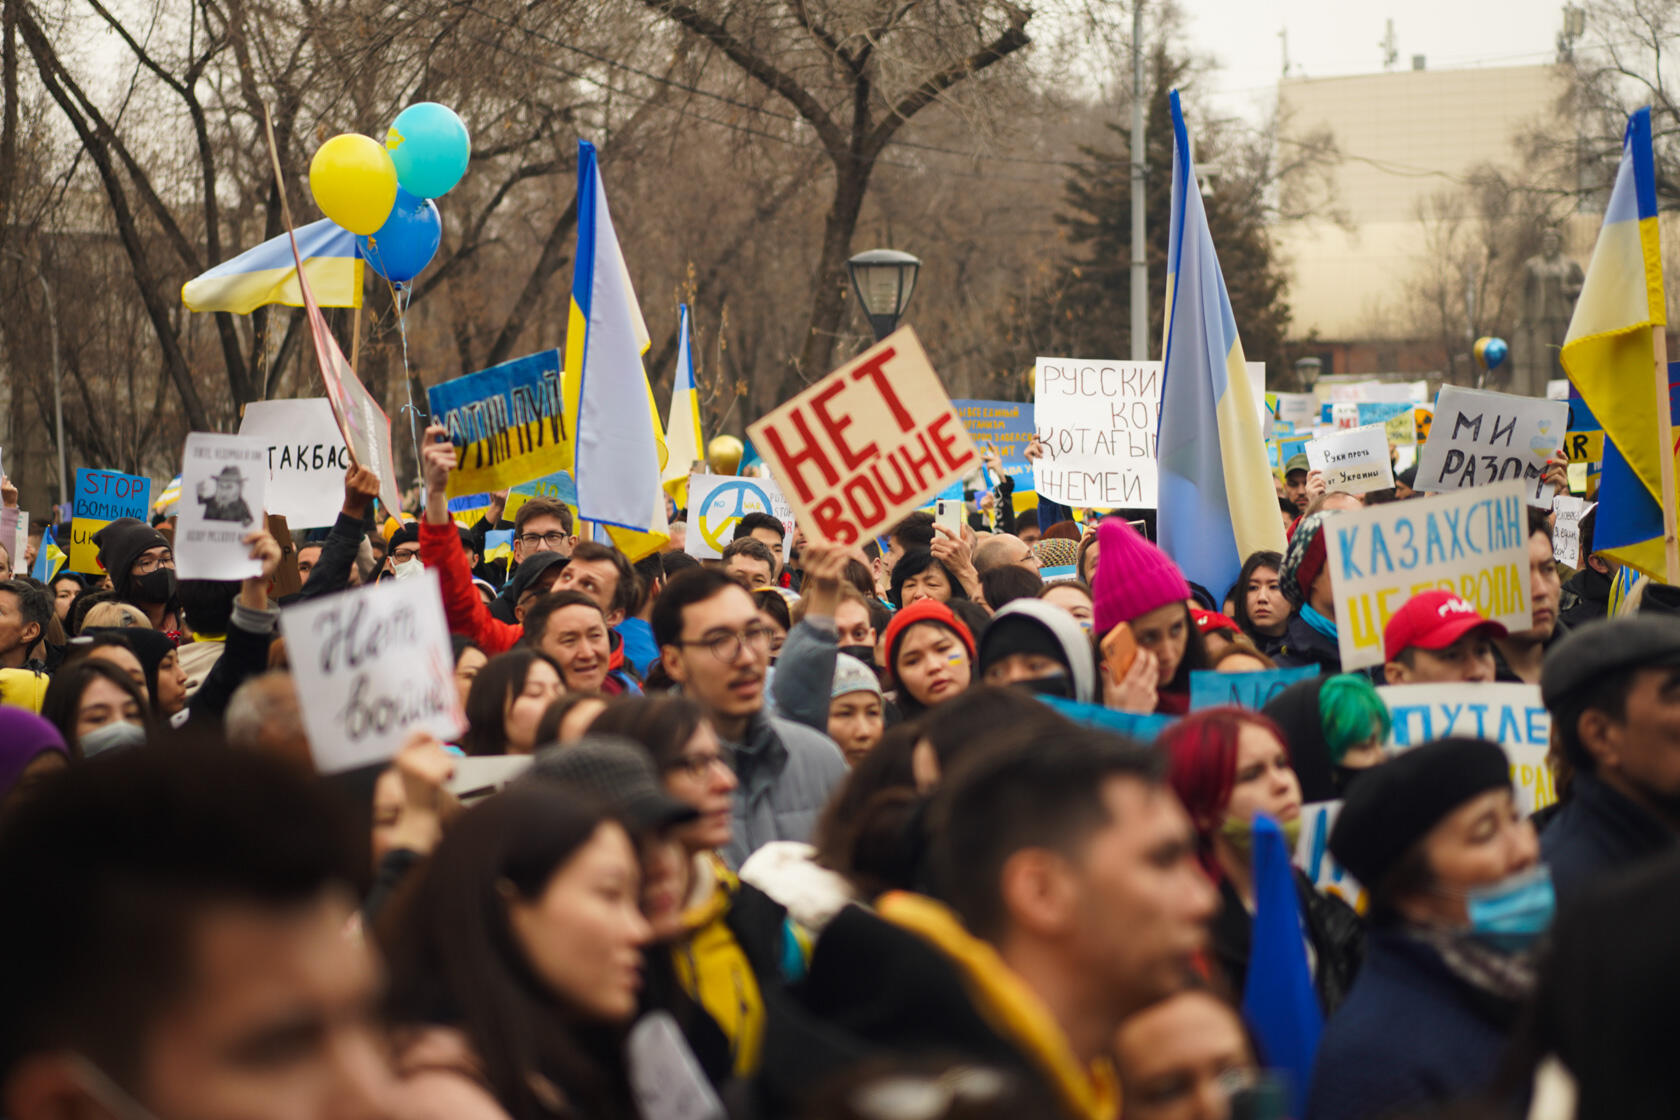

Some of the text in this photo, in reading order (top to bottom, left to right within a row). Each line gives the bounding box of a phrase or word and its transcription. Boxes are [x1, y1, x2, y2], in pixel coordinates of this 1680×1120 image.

[762, 346, 916, 505] НЕТ
[1451, 411, 1518, 447] МИ
[83, 473, 144, 500] STOP
[1041, 468, 1143, 503] ЖЕМЕЙ
[1337, 495, 1522, 581] КАЗАХСТАН
